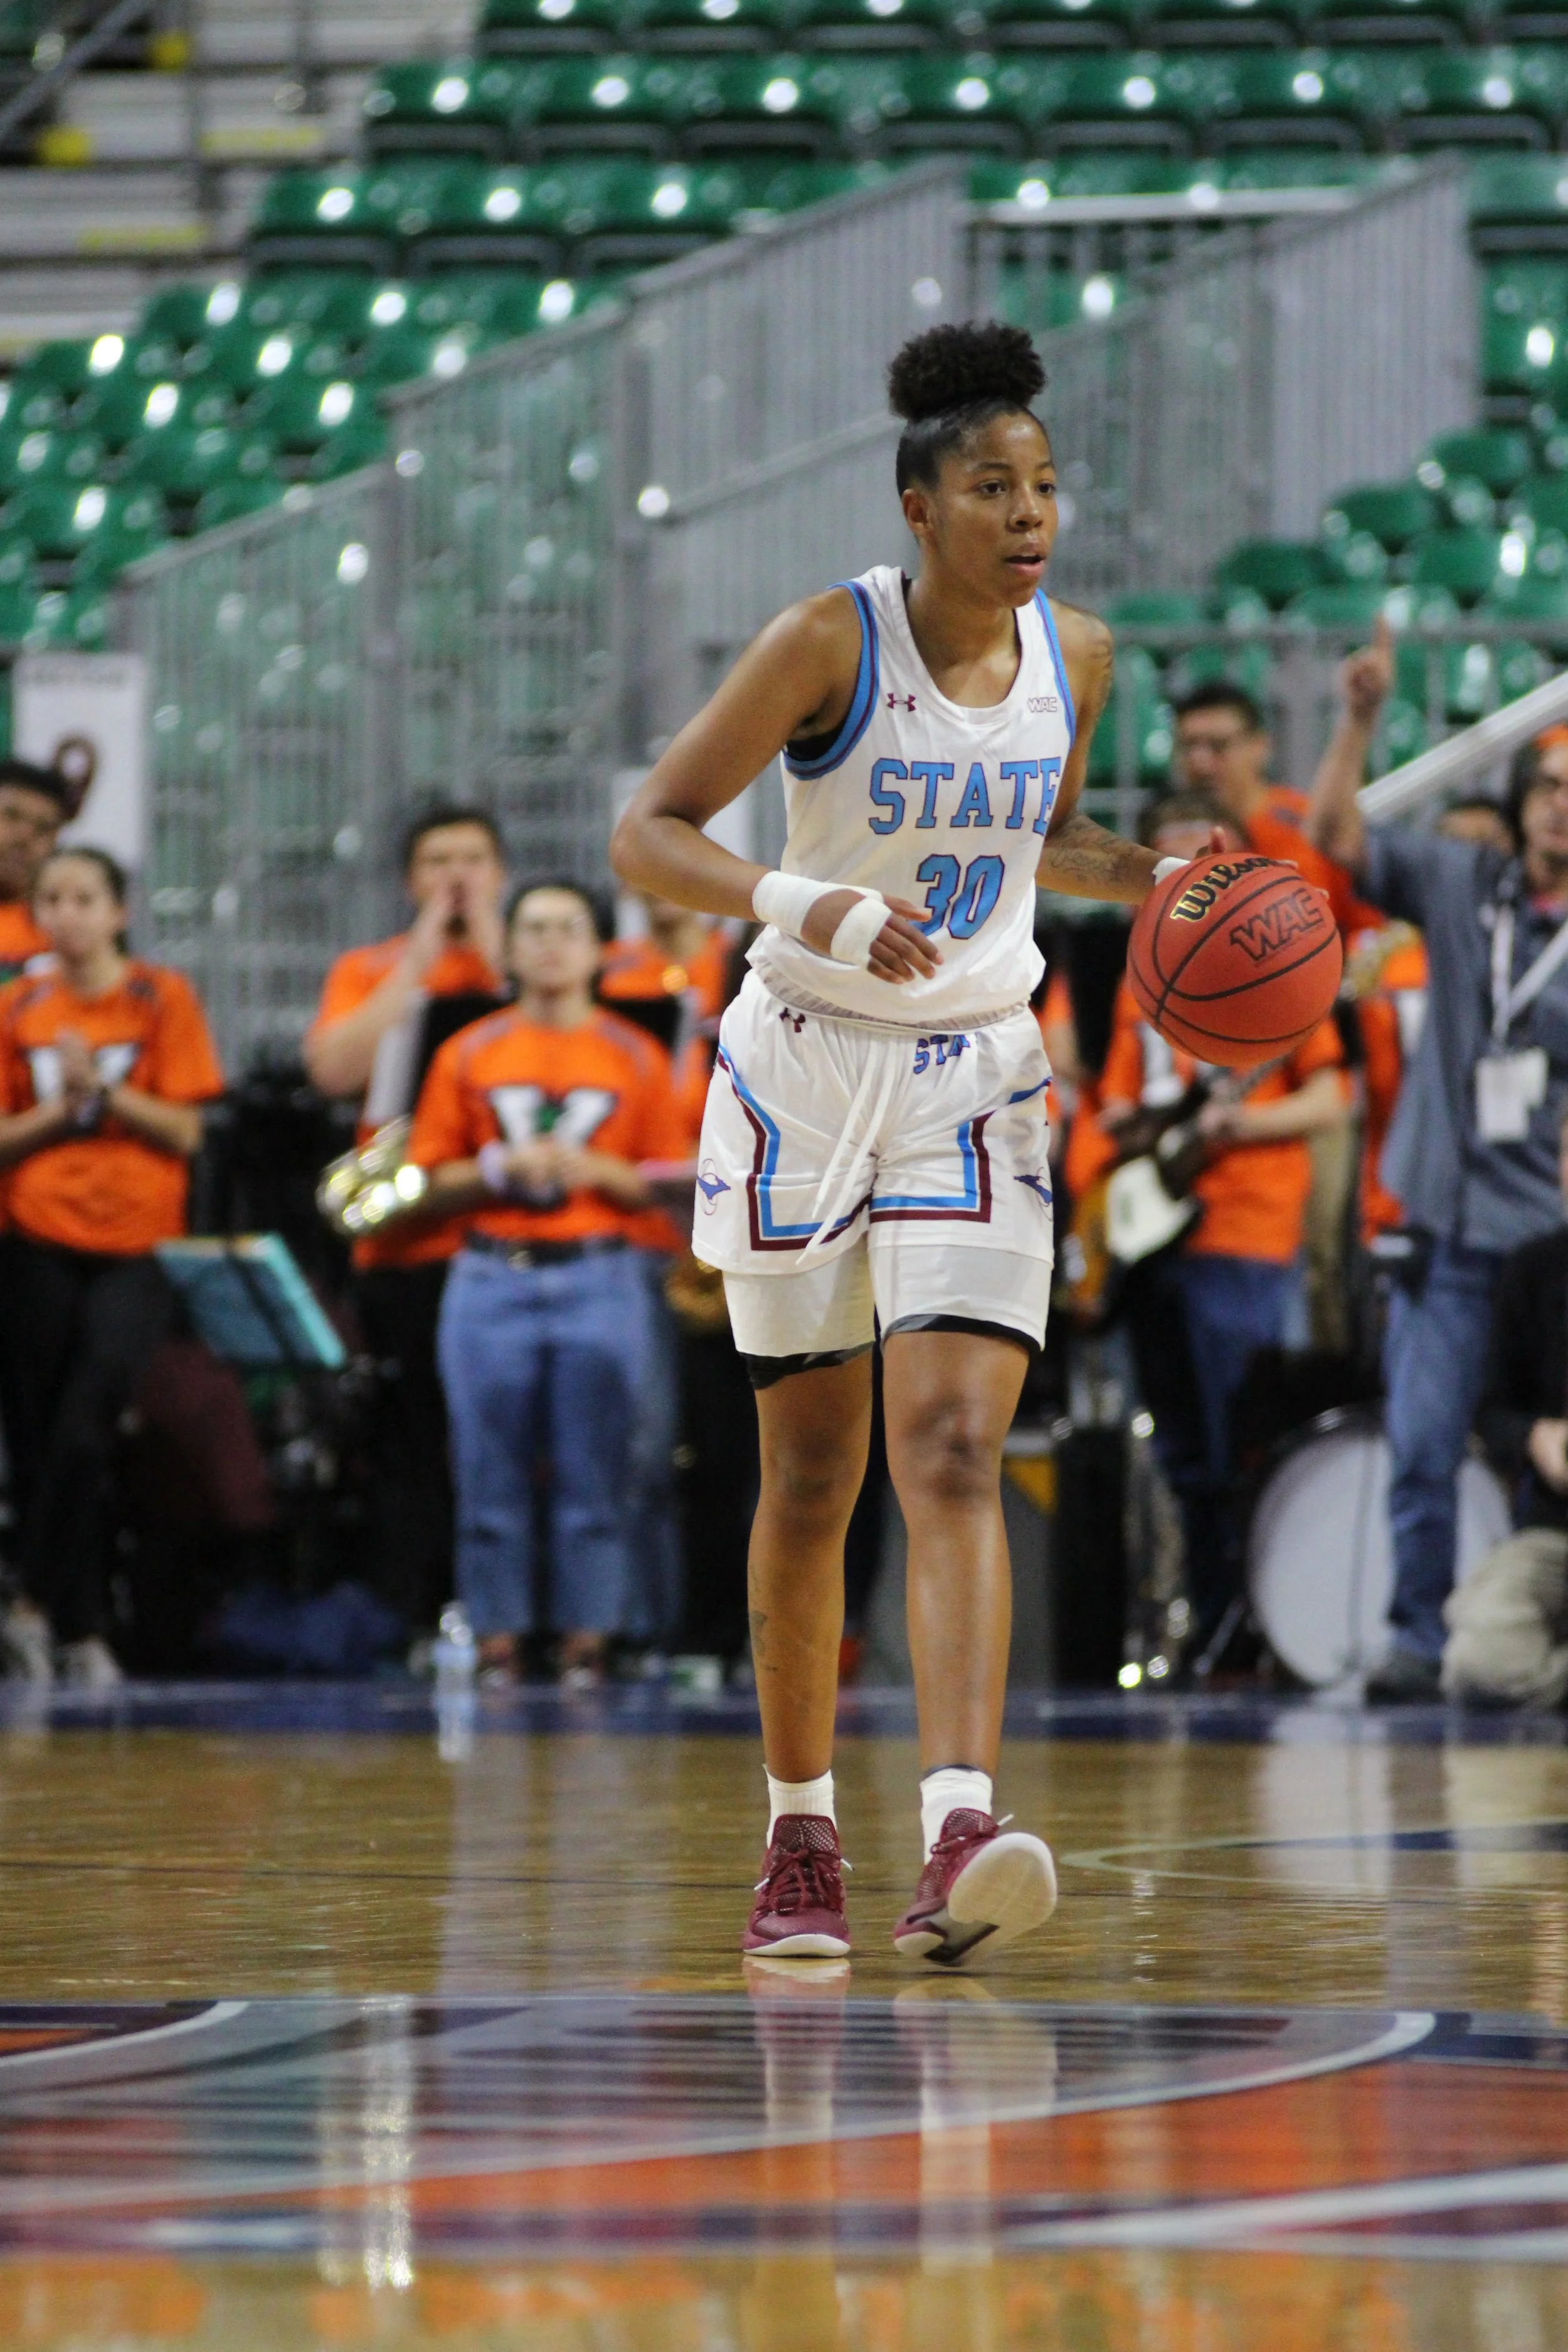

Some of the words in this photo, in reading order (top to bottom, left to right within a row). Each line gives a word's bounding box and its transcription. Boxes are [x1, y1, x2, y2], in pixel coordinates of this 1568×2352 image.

[1027, 696, 1057, 713] WAC
[868, 756, 1061, 836] STATE
[909, 853, 1005, 940] 30
[1229, 887, 1324, 961] WAC
[913, 1034, 972, 1074] STA
